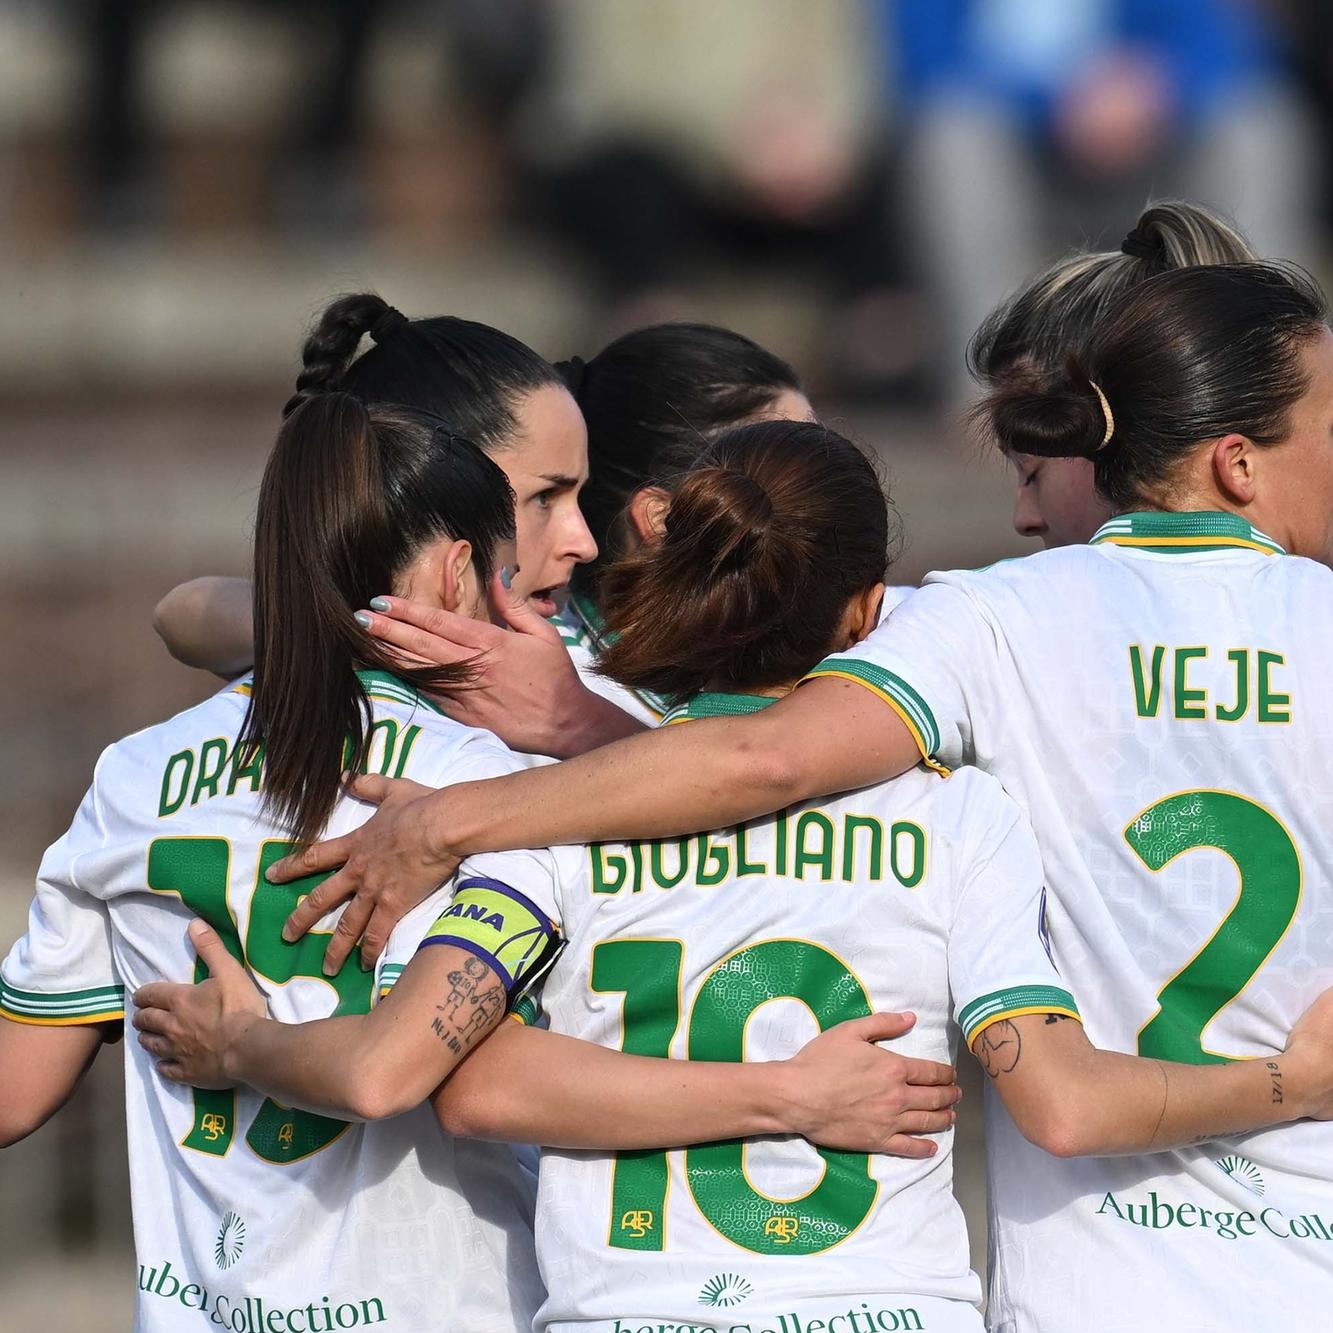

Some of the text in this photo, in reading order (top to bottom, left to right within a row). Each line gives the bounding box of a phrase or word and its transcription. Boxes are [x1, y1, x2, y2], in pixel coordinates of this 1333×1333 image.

[1129, 644, 1293, 724] VEJE
[588, 808, 927, 895] GIUGLIANO
[438, 901, 505, 932] ANA
[1124, 788, 1304, 1066] 2
[590, 937, 881, 1256] 10
[1265, 1062, 1284, 1105] 17/18
[1096, 1191, 1257, 1240] Auberge
